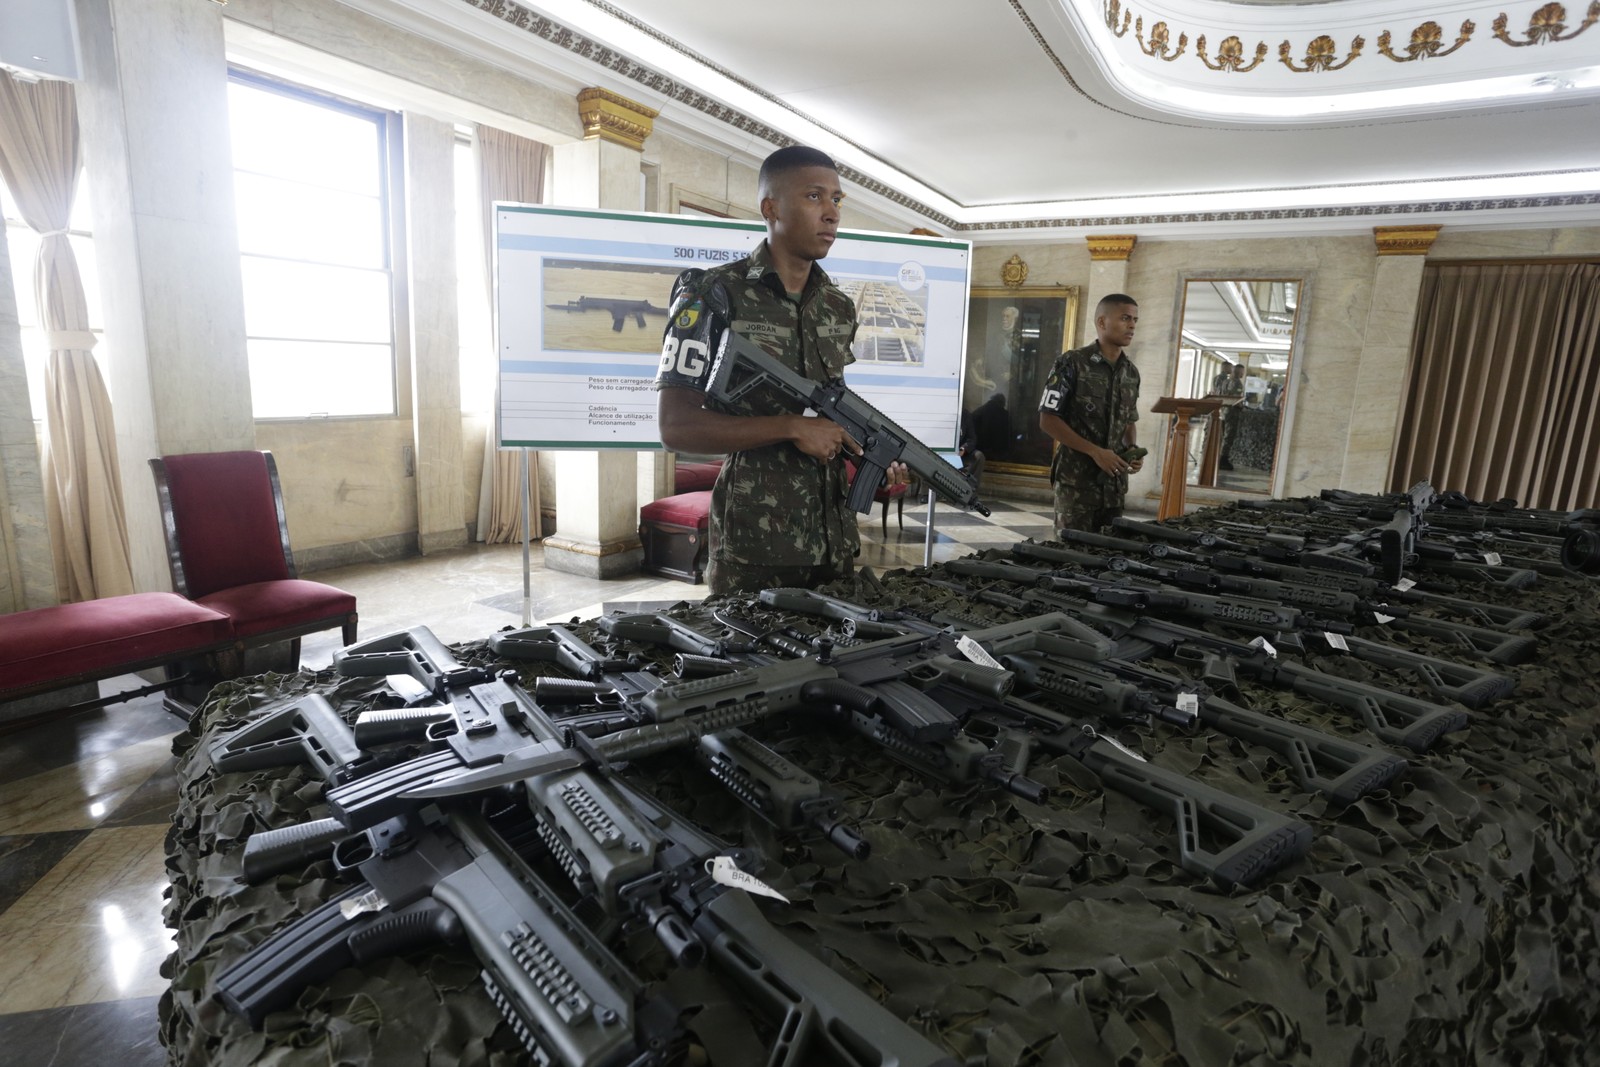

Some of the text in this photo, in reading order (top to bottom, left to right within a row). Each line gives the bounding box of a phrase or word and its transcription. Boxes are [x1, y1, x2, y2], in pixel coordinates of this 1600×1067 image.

[673, 247, 694, 259] 500
[697, 249, 730, 261] FUZIS
[745, 324, 777, 333] JORDAN
[661, 336, 708, 378] BG
[731, 872, 751, 883] BRA
